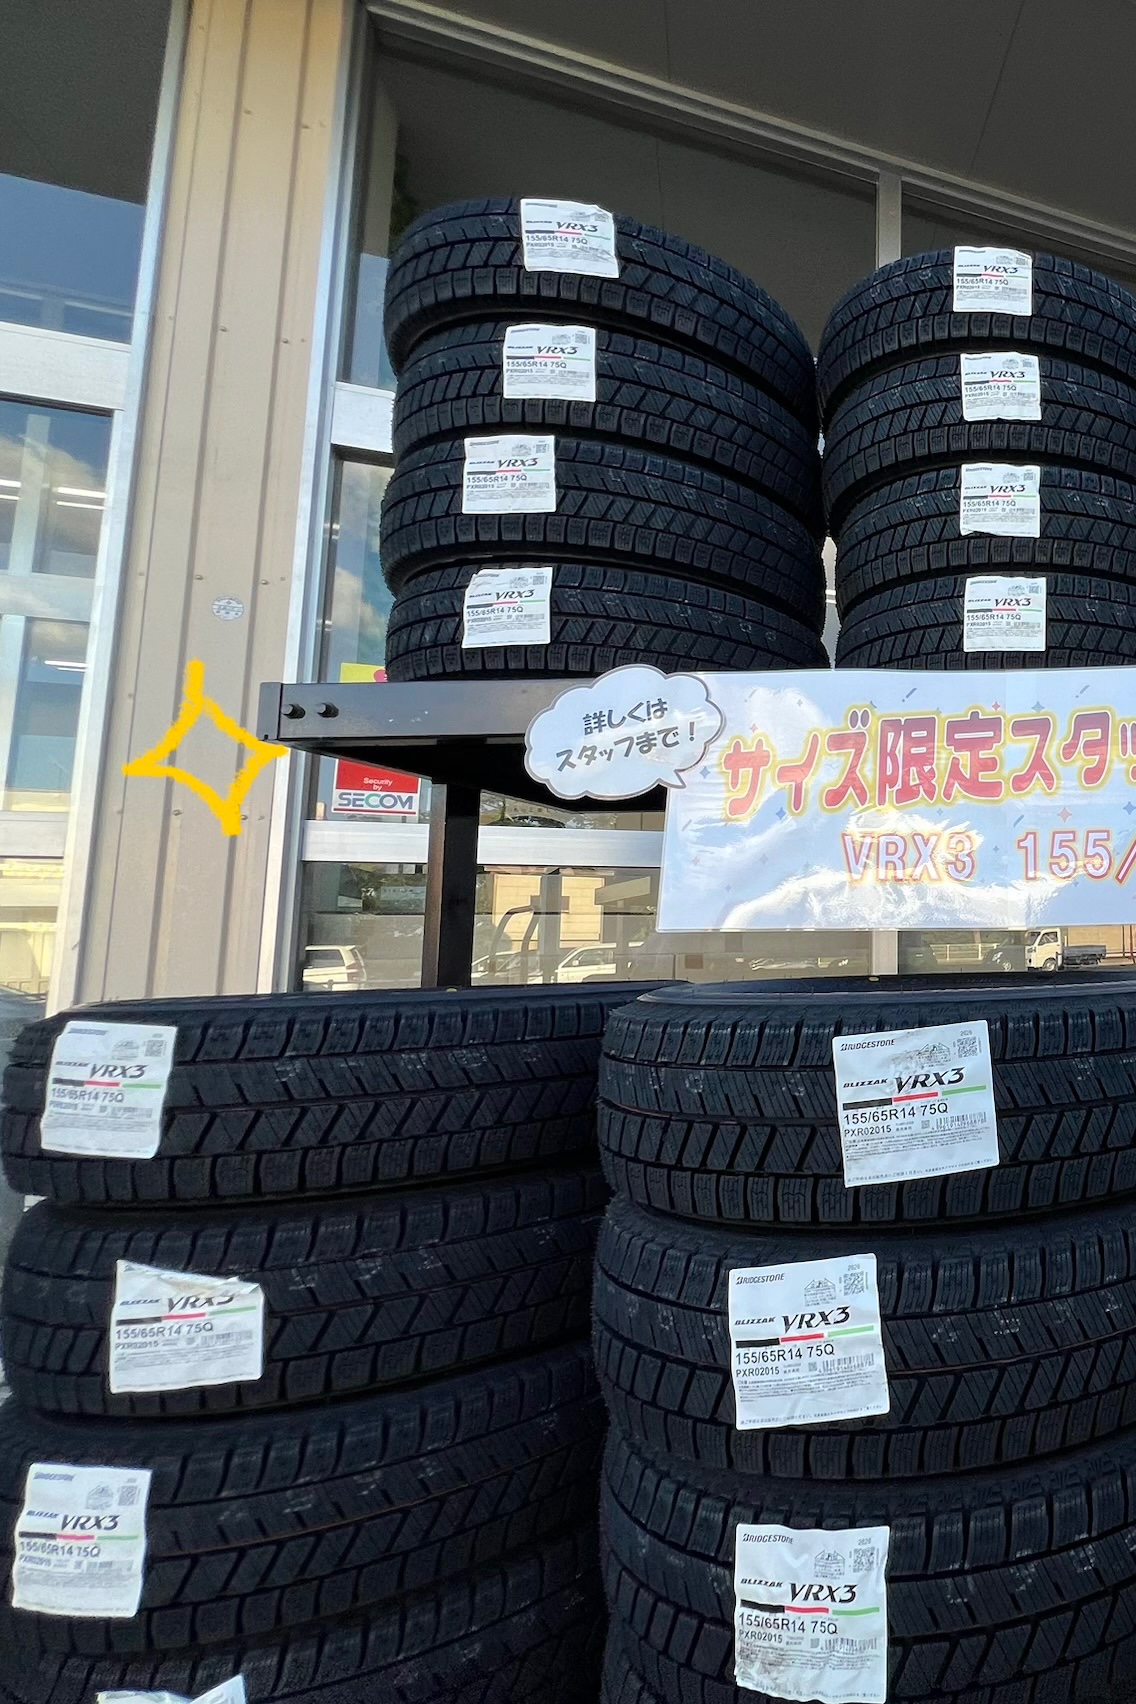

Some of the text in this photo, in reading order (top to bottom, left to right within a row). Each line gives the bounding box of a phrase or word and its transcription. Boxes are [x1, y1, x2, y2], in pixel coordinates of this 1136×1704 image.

[556, 221, 598, 232] VRX3
[526, 235, 588, 245] 155/65R14 75Q
[983, 265, 1018, 274] VRX3
[536, 346, 578, 355] VRX3
[965, 384, 1001, 393] 155/65R14
[497, 457, 539, 468] VRX3
[467, 475, 508, 484] 155/65R14
[990, 484, 1026, 493] VRX3
[963, 500, 1000, 508] 155/65R14
[495, 589, 536, 601] VRX3
[994, 597, 1032, 607] VRX3
[467, 608, 505, 617] 155/65R14
[583, 698, 668, 736] 詳しくは
[556, 721, 695, 772] スタッフまで！
[363, 777, 394, 786] Security
[338, 792, 414, 809] SECOM
[842, 831, 976, 882] VRX3
[840, 1039, 896, 1052] BRIDGESTONE
[90, 1063, 148, 1079] VRX3
[842, 1066, 966, 1094] BLIZZAK VRX3
[843, 1104, 948, 1125] 155/65R14 75Q
[844, 1125, 892, 1138] PXR02015
[735, 1273, 785, 1285] BRIDGESTONE
[734, 1305, 851, 1334] BLIZZAK VRX3
[116, 1322, 214, 1340] 155/65R14 75Q
[735, 1343, 835, 1365] 155/65R14 75Q
[735, 1366, 780, 1377] PXR02015
[60, 1514, 121, 1531] VRX3
[742, 1533, 794, 1544] BRIDGESTONE
[740, 1578, 859, 1604] BLIZZAK VRX3
[739, 1612, 839, 1635] 155/65R14 75Q
[739, 1629, 783, 1643] PXR02015
